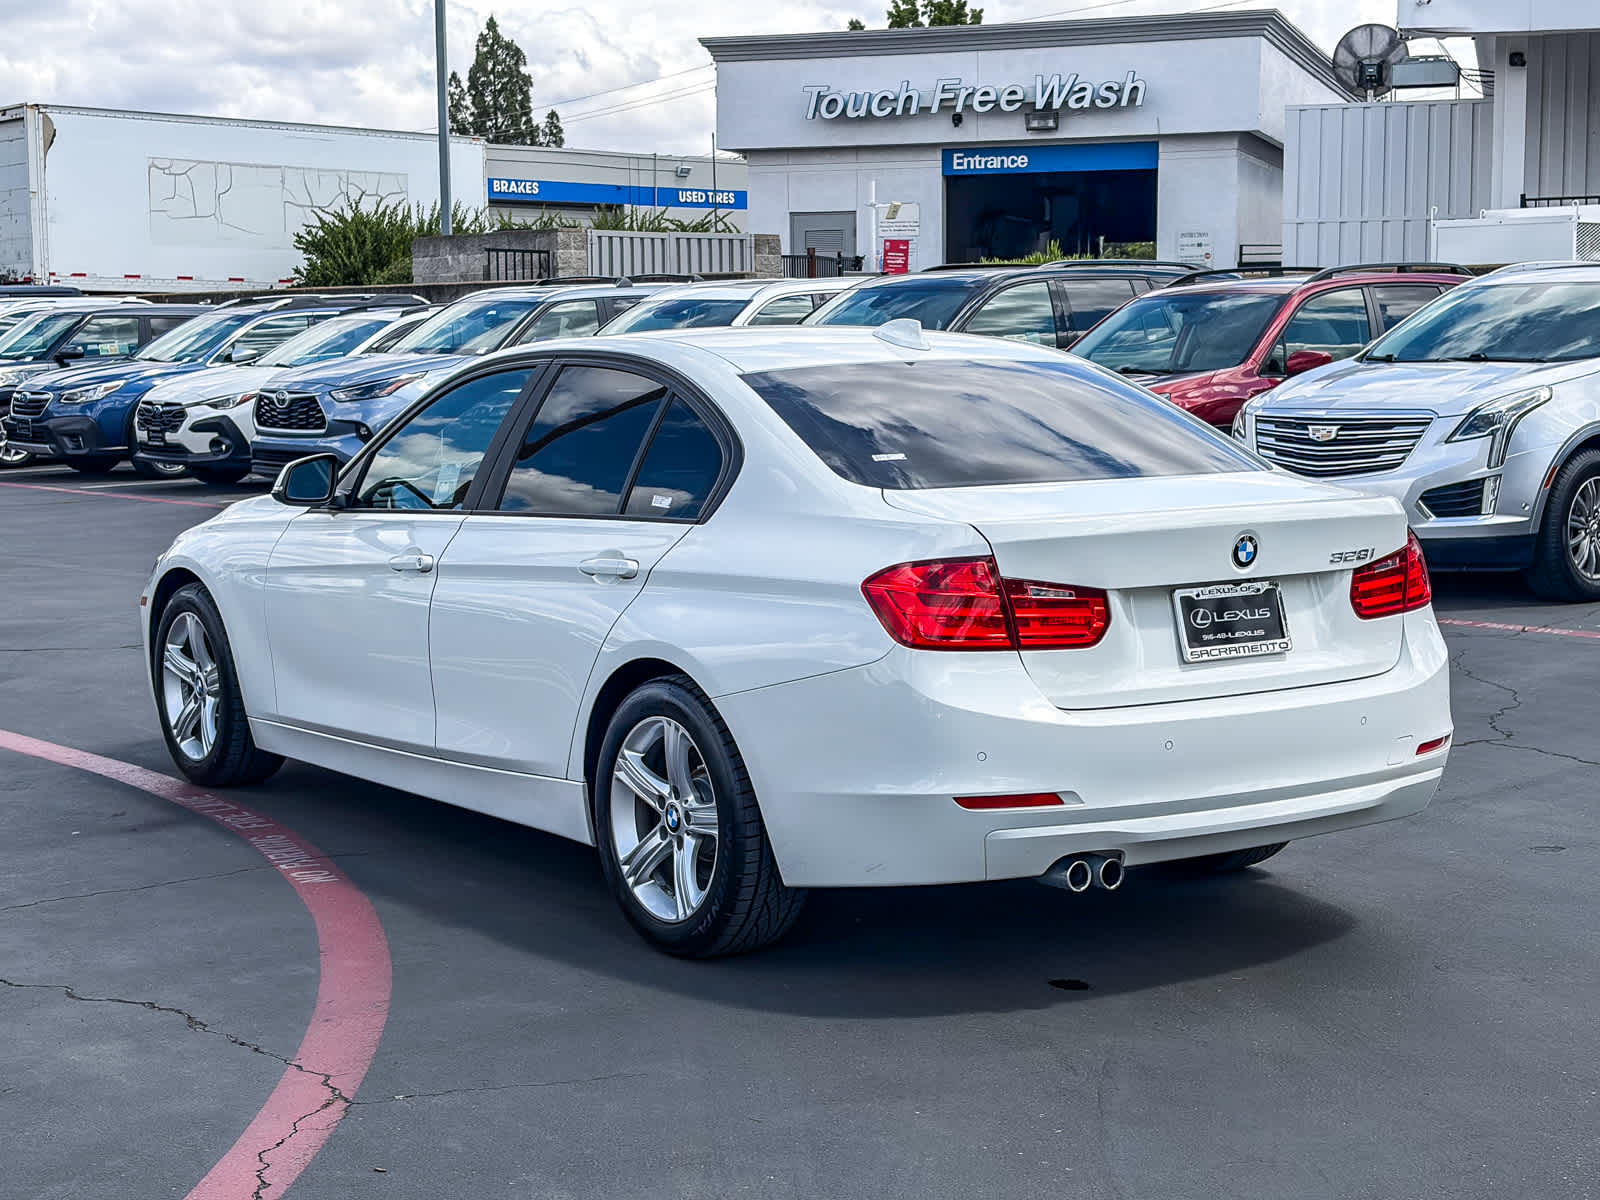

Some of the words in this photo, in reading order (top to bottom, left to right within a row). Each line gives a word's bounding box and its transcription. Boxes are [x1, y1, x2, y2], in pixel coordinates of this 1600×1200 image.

[802, 80, 920, 120] Touch
[930, 78, 1025, 114] Free
[1035, 70, 1147, 110] Wash
[953, 153, 1029, 170] Entrance
[493, 180, 539, 194] BRAKES
[678, 190, 706, 203] USED
[1329, 547, 1375, 563] 328i
[1200, 586, 1238, 596] LEXUS
[1240, 584, 1256, 592] OF
[1213, 607, 1270, 622] LEXUS
[1190, 641, 1289, 659] SACRAMENTO
